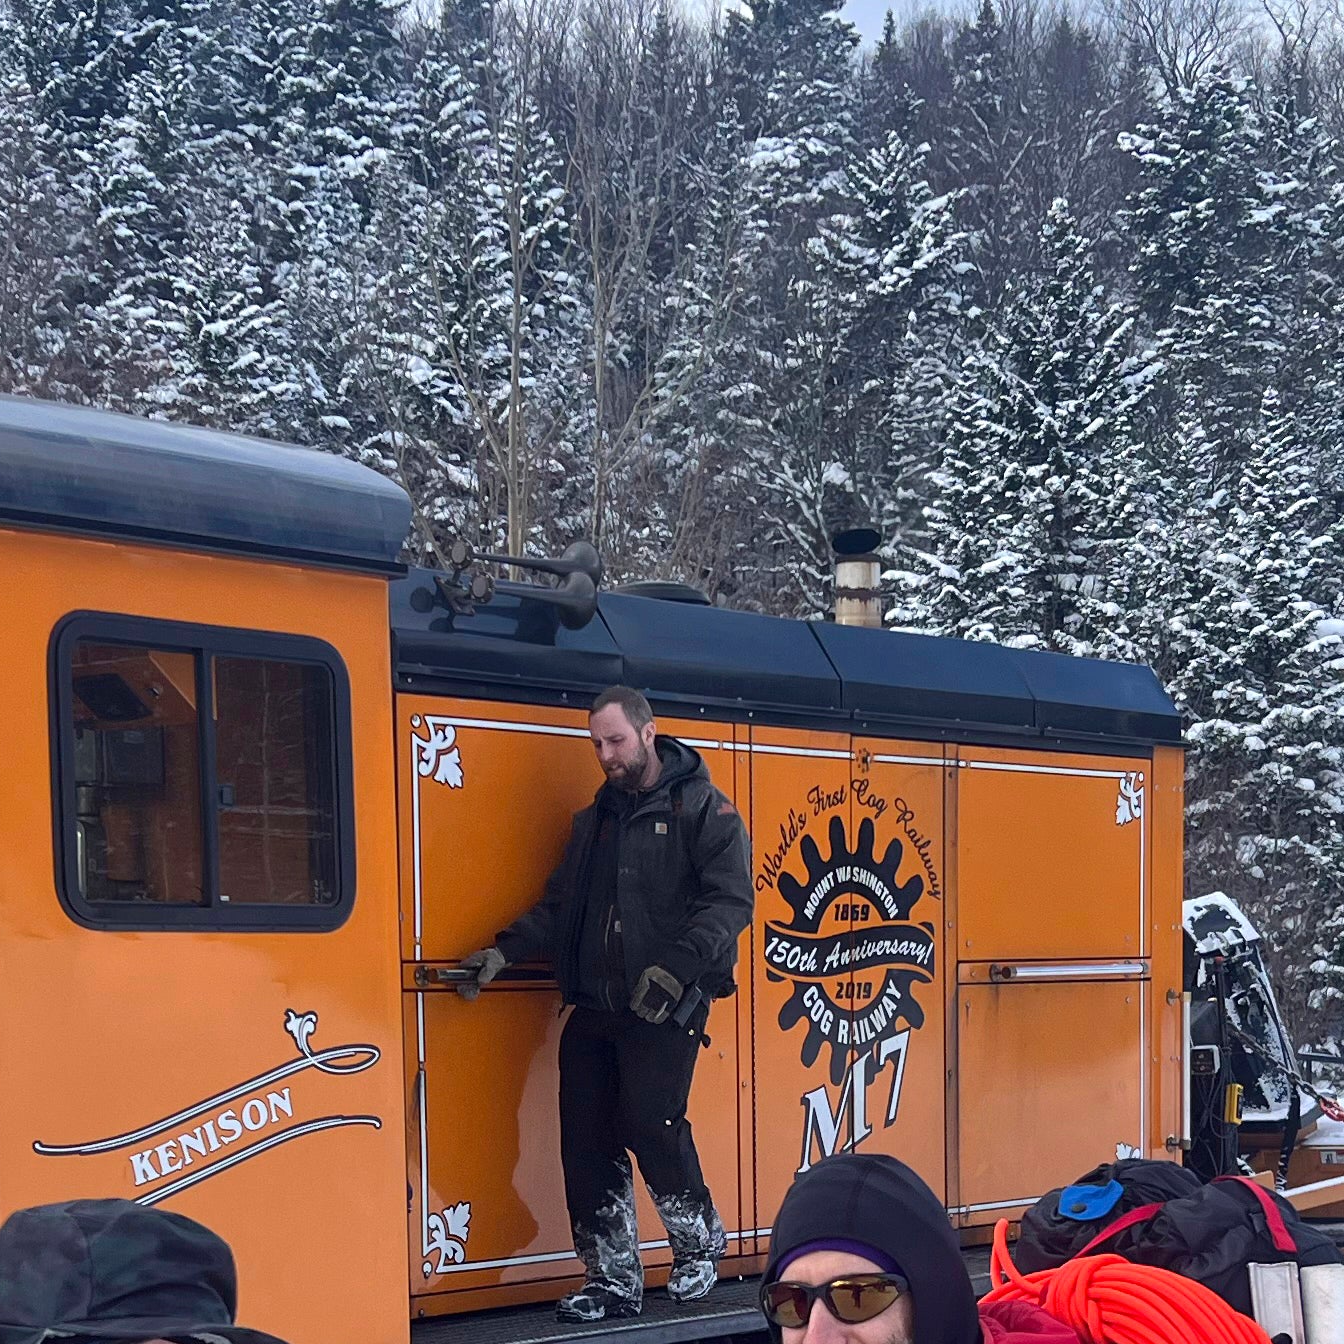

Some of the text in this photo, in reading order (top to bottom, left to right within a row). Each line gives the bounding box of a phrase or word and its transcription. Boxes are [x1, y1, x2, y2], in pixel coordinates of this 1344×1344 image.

[756, 778, 942, 901] World's First Cog Railway
[803, 866, 899, 920] MOUNT WASHINGTON
[834, 904, 870, 921] 1869
[765, 937, 934, 973] 150th Anniversary!
[803, 979, 902, 1045] COG RAILWAY
[835, 982, 873, 999] 2019
[128, 1087, 295, 1187] KENISON
